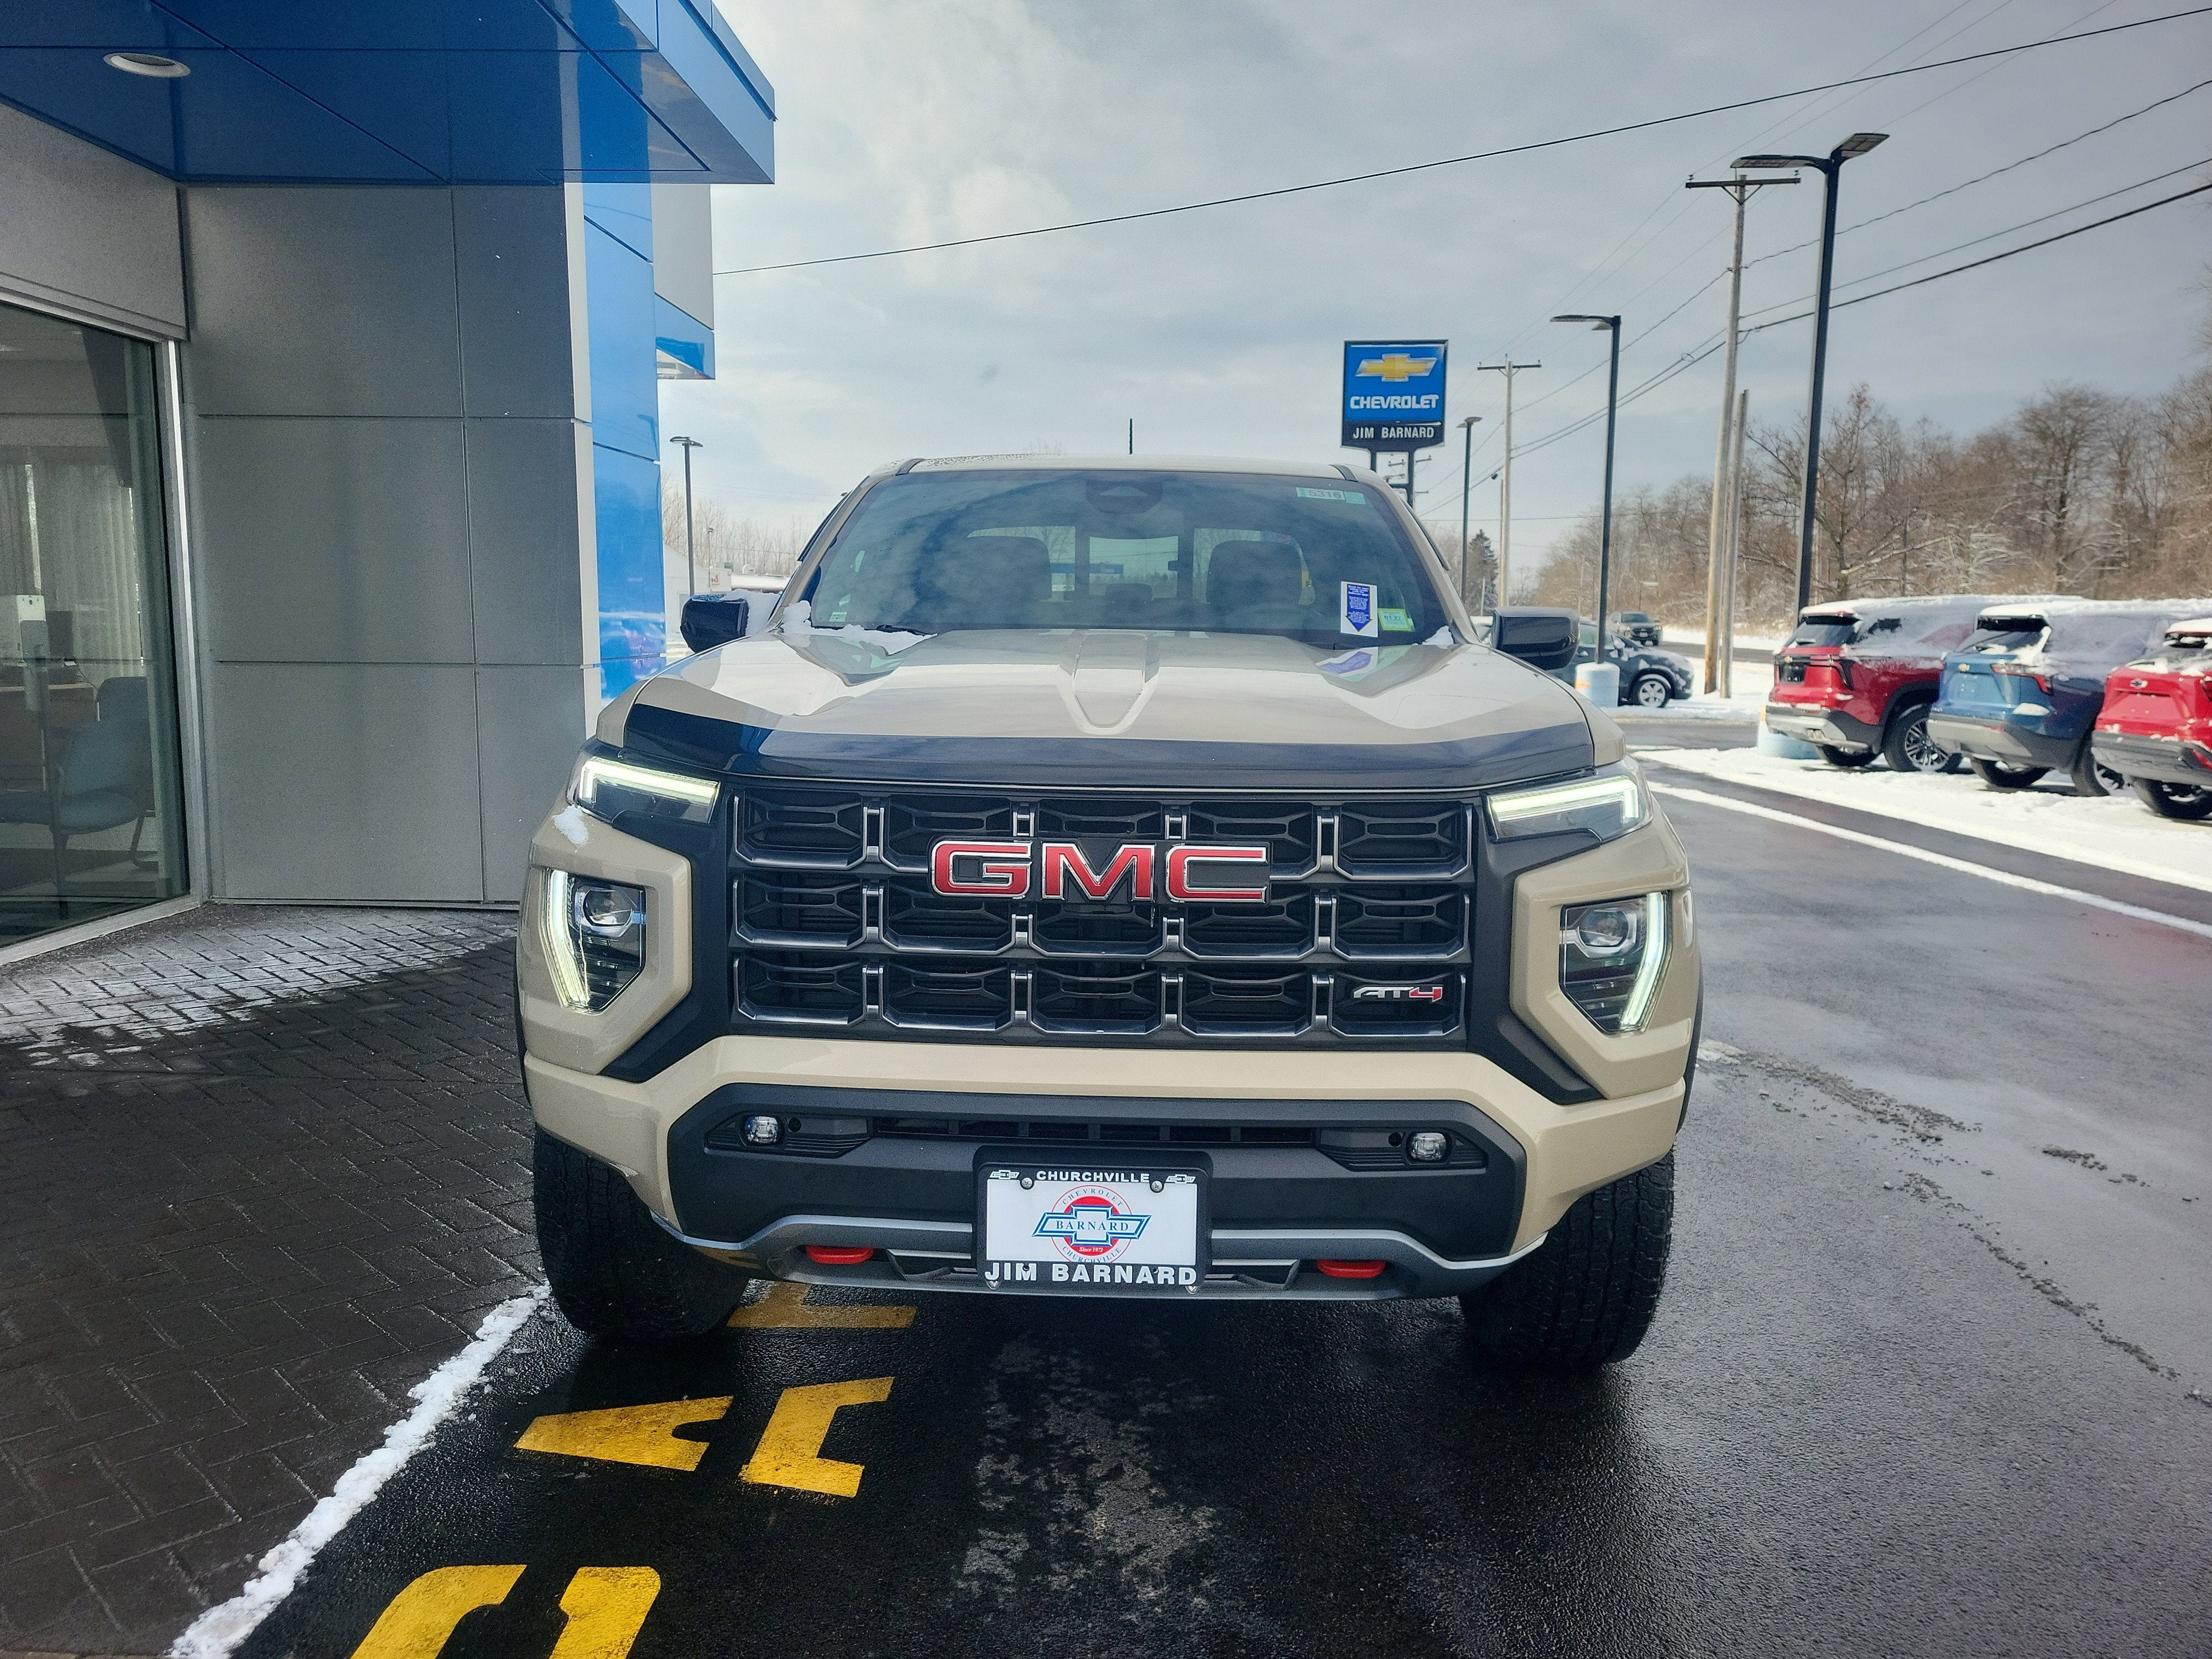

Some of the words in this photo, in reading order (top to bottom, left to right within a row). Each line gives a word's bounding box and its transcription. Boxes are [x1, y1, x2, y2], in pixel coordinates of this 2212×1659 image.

[1350, 394, 1439, 409] CHEVROLET
[1353, 426, 1375, 439] JIM
[1382, 426, 1435, 439] BARNARD
[931, 840, 1267, 903] GMC
[1353, 987, 1443, 1003] AT4
[1036, 1170, 1150, 1183] CHURCHVILLE
[1062, 1187, 1123, 1207] CHEVROLET
[1056, 1220, 1129, 1232] BARNARD
[984, 1262, 1037, 1281] JIM
[1051, 1264, 1197, 1285] BARNARD
